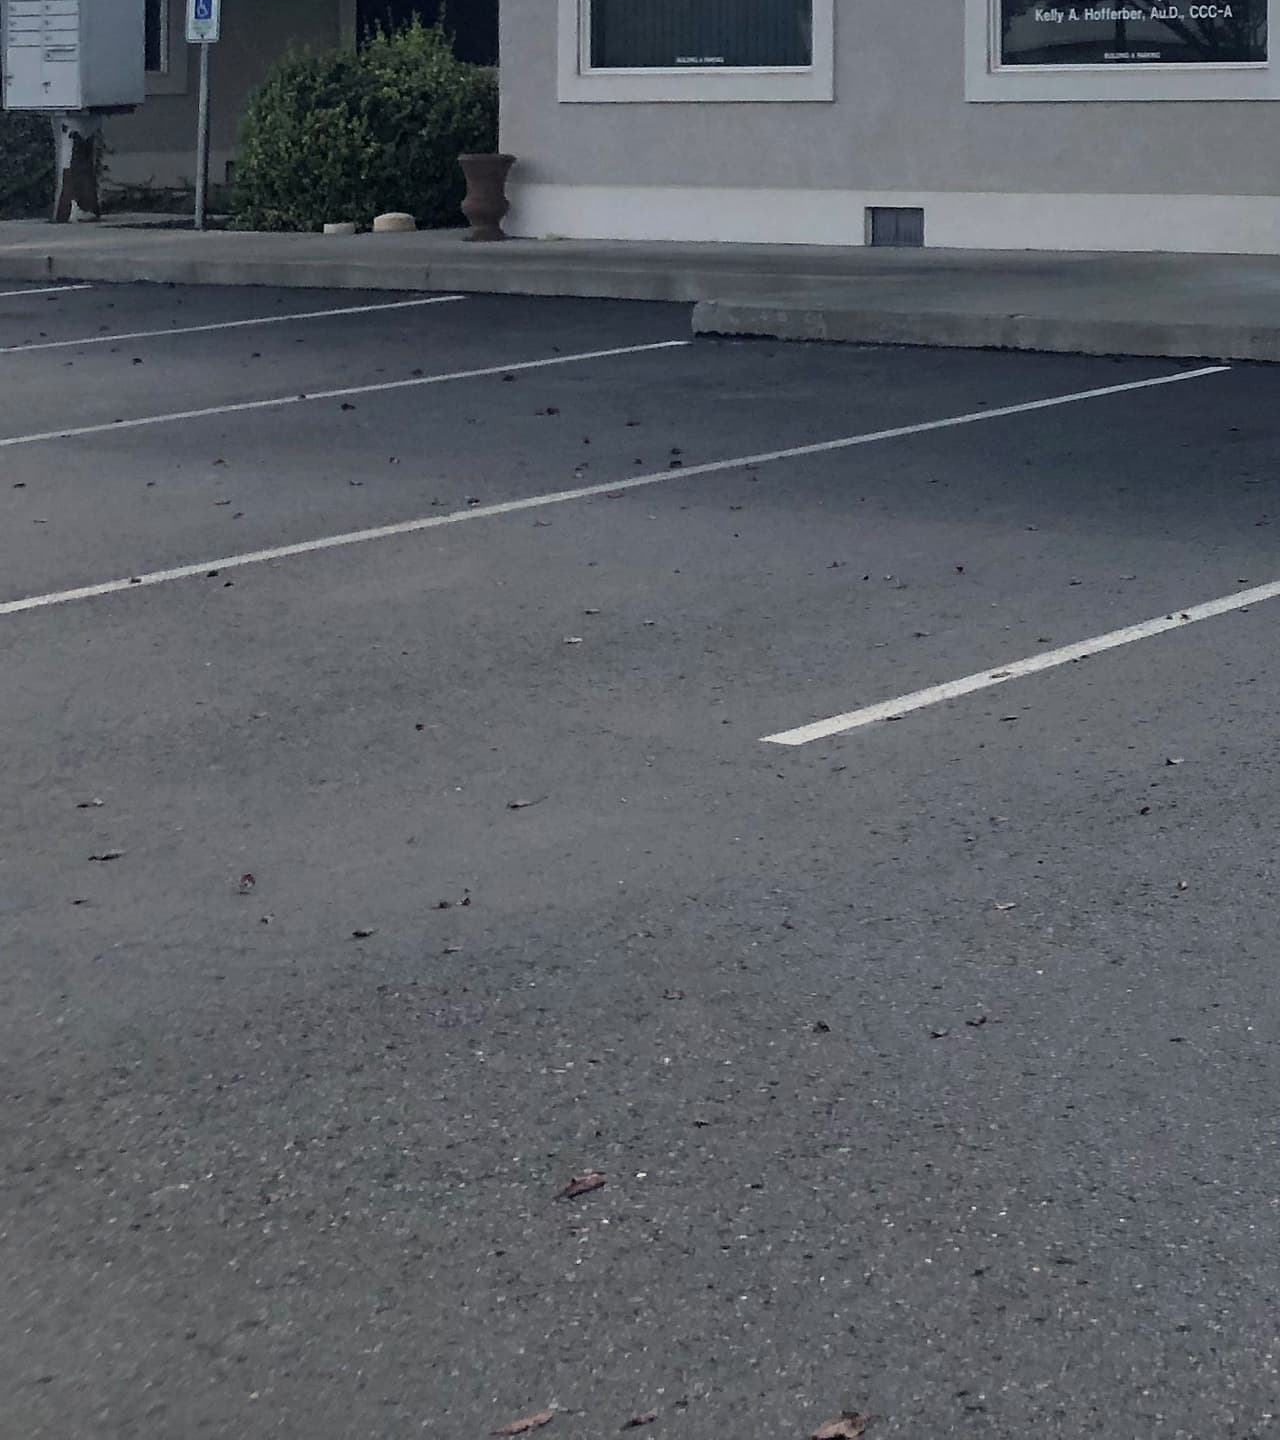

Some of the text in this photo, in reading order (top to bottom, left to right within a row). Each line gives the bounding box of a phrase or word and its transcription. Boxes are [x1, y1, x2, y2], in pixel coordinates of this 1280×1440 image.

[1035, 9, 1064, 23] Kelly
[1068, 9, 1080, 21] A.
[1189, 5, 1233, 19] CCC-A
